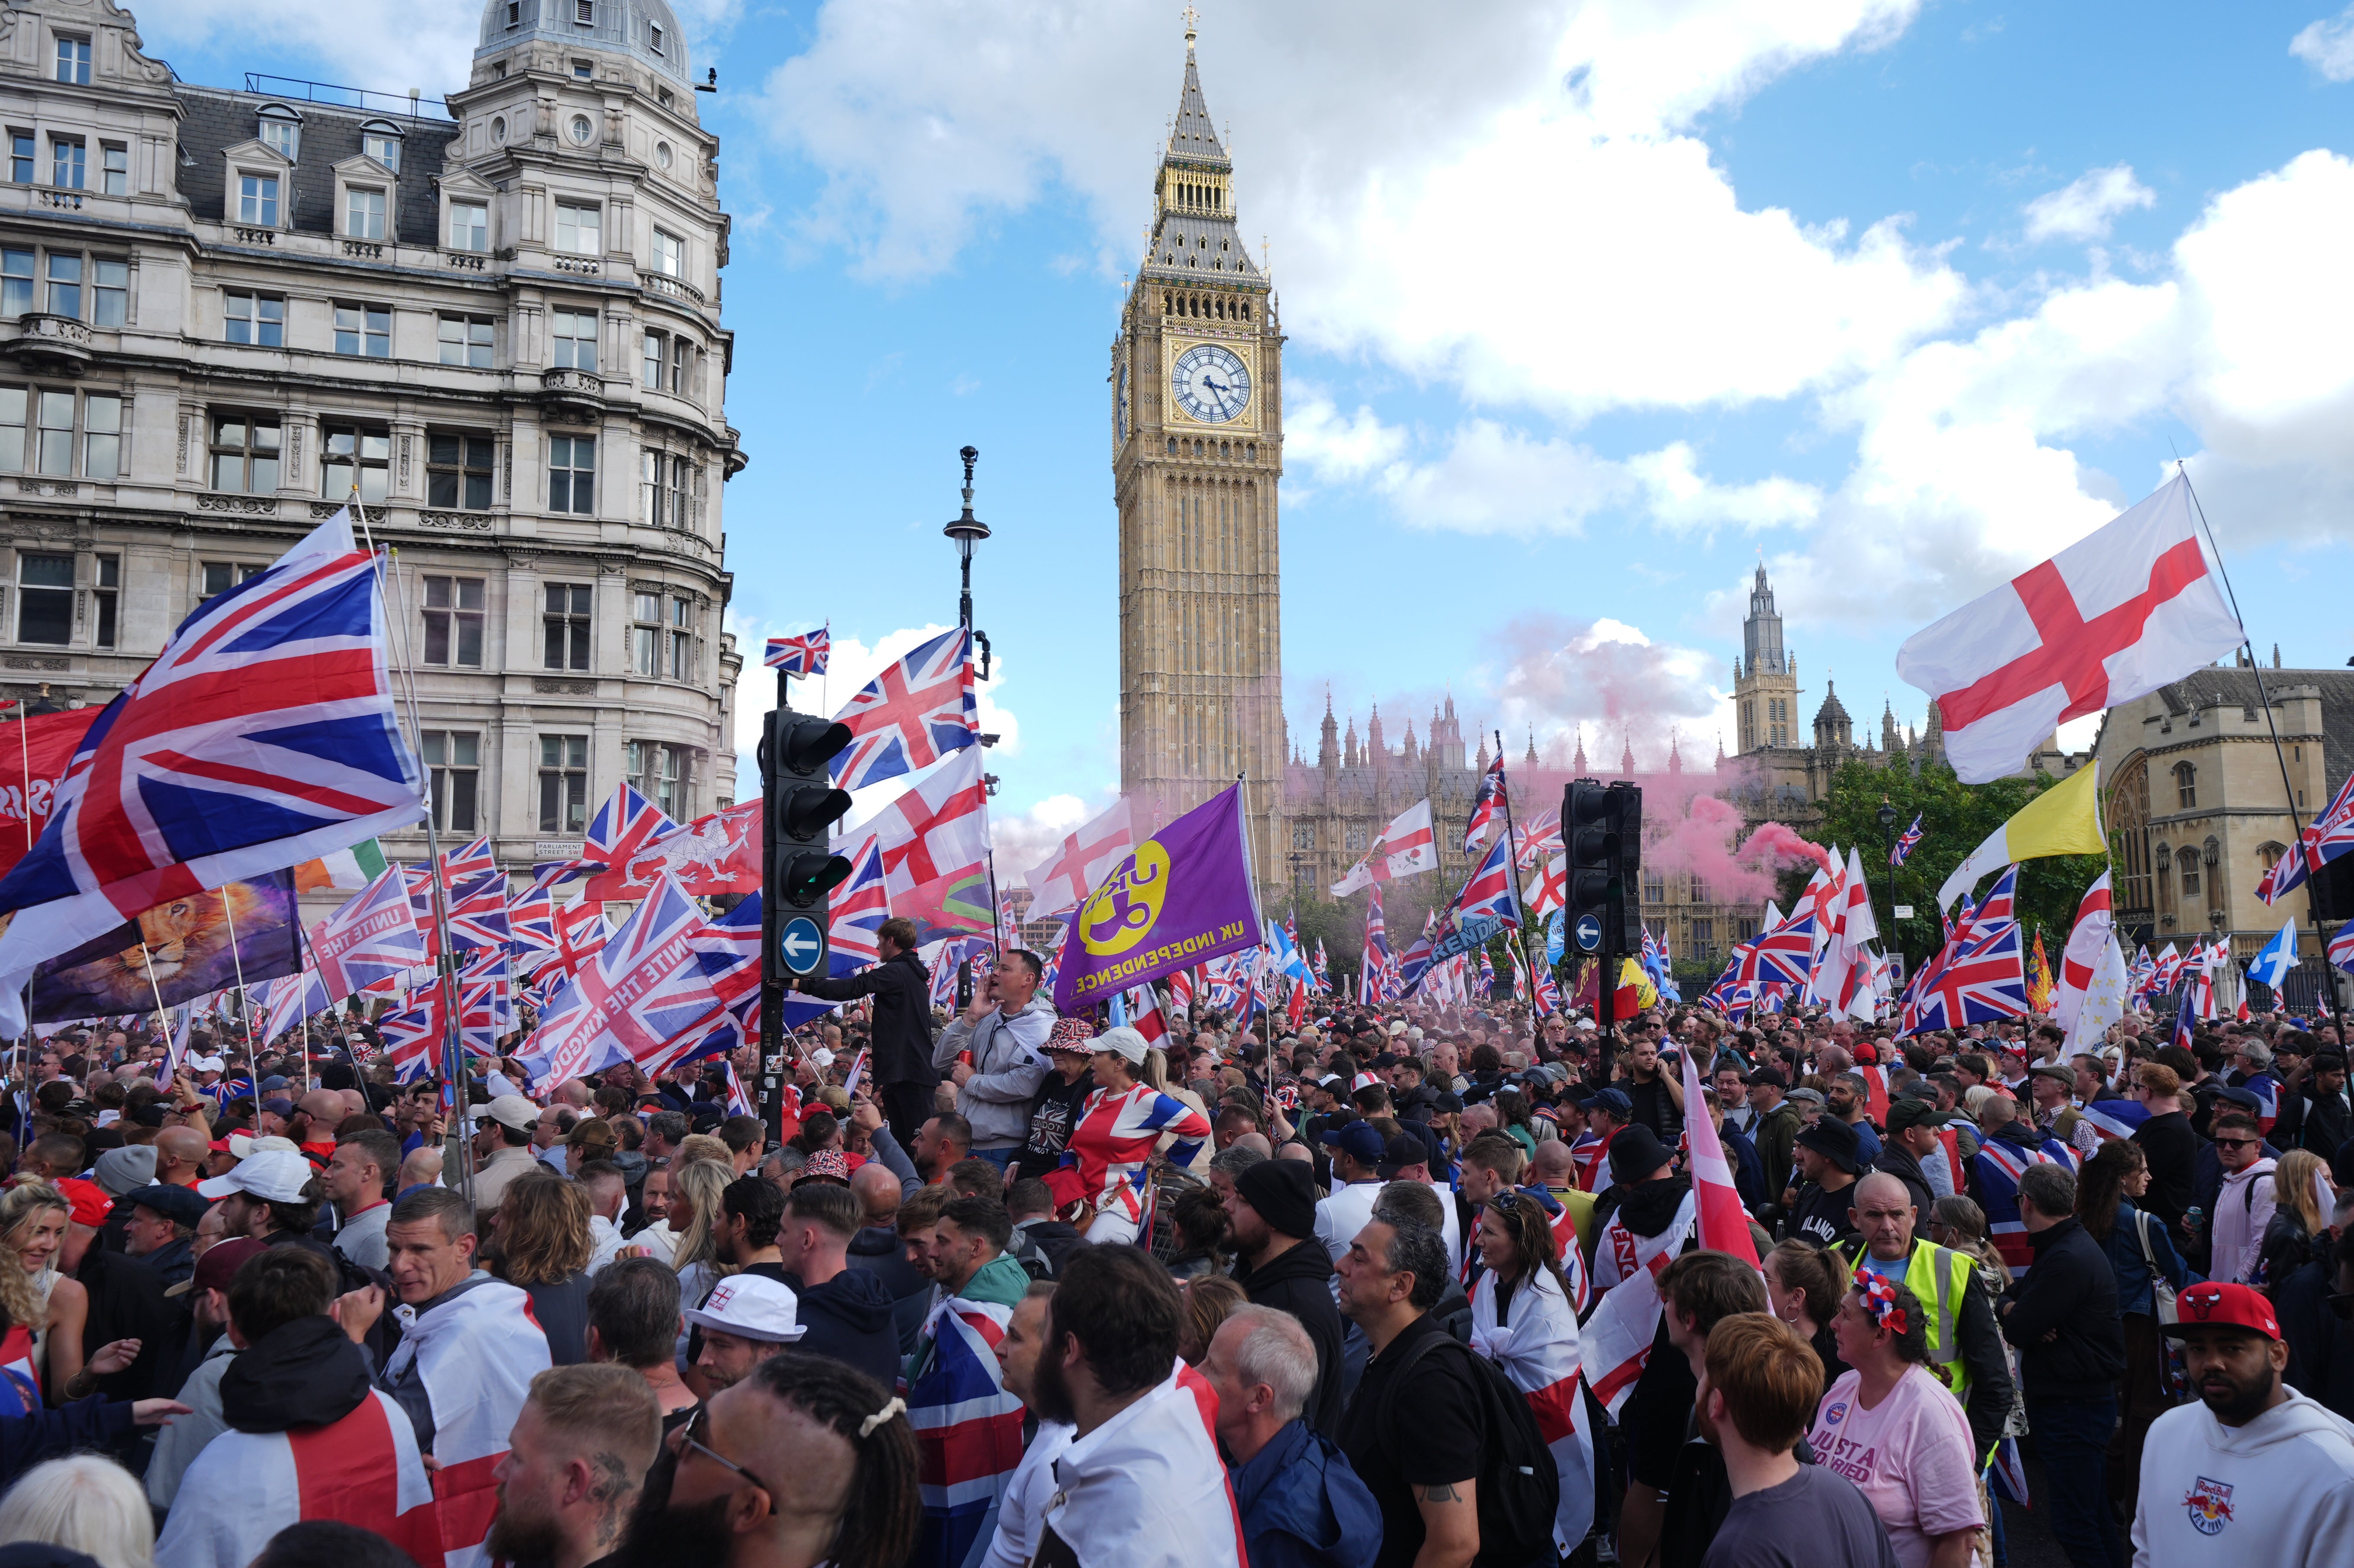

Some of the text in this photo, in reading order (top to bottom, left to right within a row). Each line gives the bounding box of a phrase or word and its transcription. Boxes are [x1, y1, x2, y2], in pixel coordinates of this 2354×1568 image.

[1033, 1146, 1049, 1154] MUST
[707, 1301, 724, 1312] ENGLAND
[1810, 1430, 1875, 1468] JUST A
